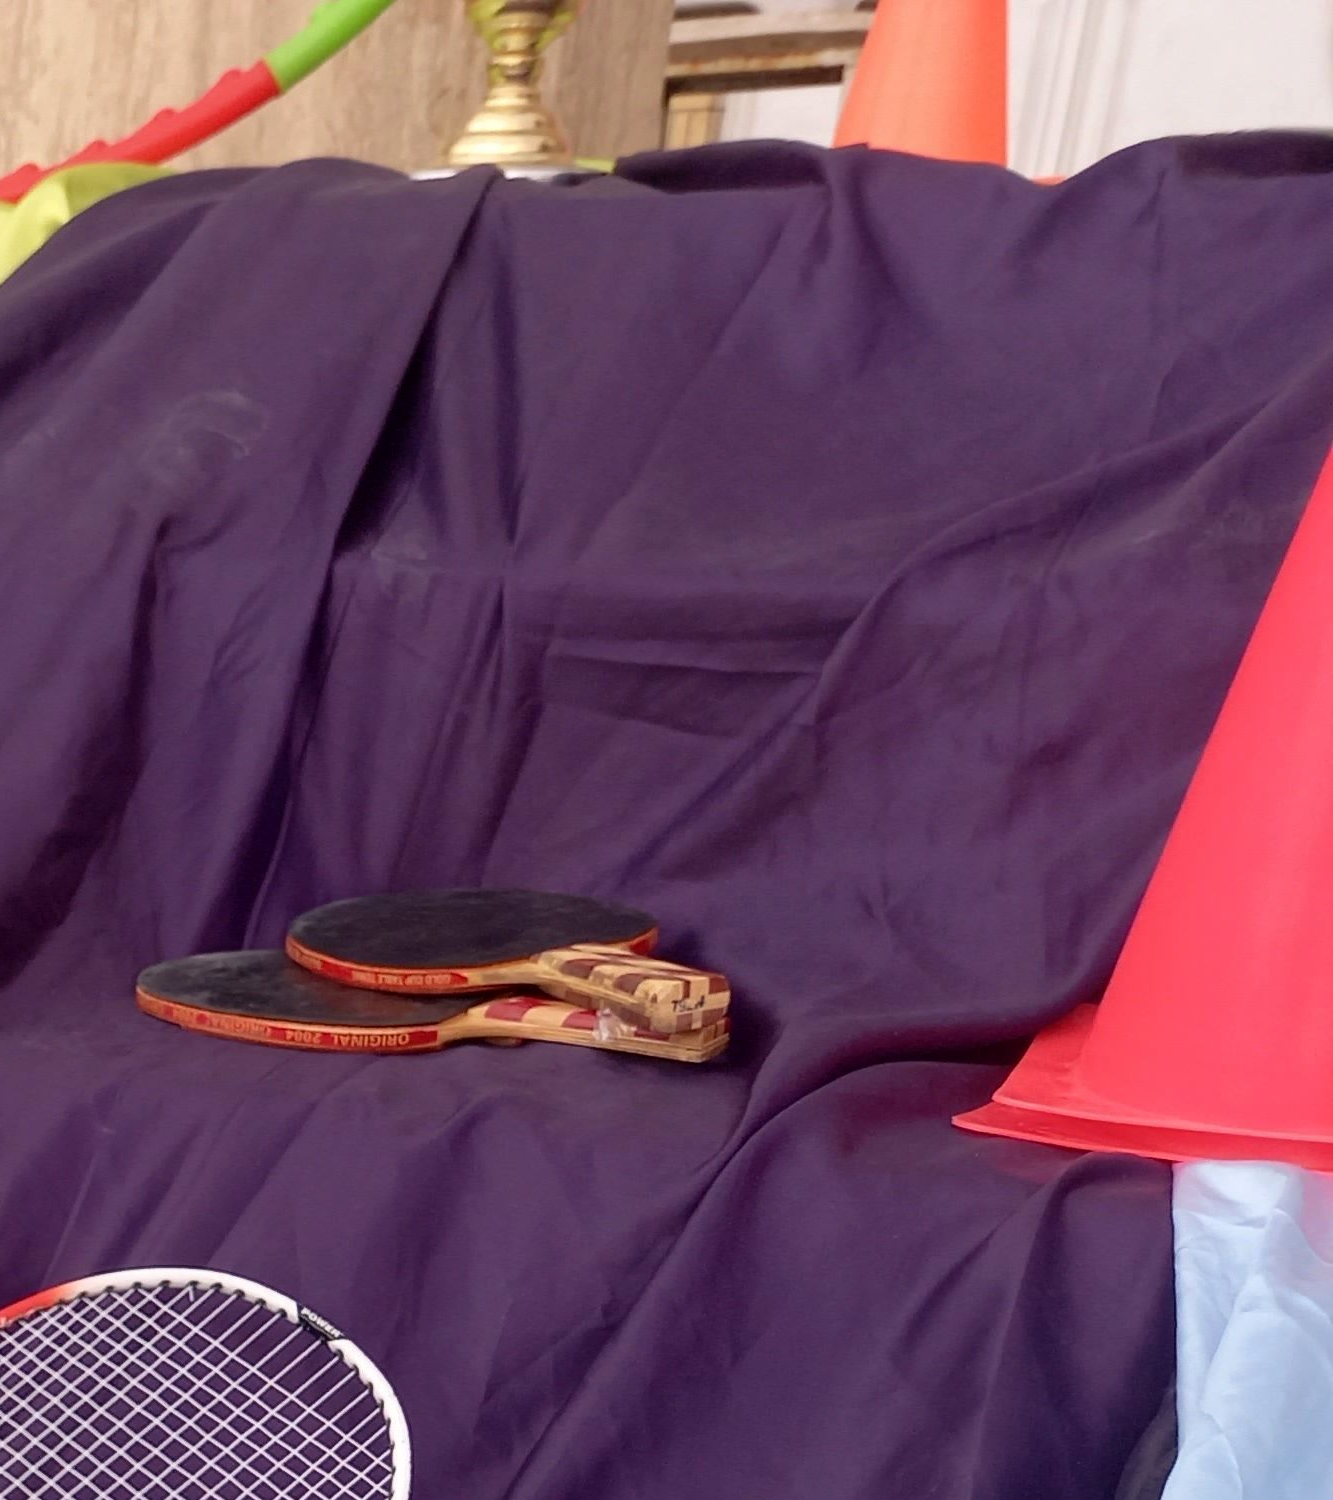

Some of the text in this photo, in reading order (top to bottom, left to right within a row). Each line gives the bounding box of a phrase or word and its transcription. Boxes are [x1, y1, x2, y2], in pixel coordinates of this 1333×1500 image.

[285, 1028, 322, 1045] 2004
[333, 1032, 410, 1047] ORIGINAL
[300, 1306, 341, 1338] POWER
